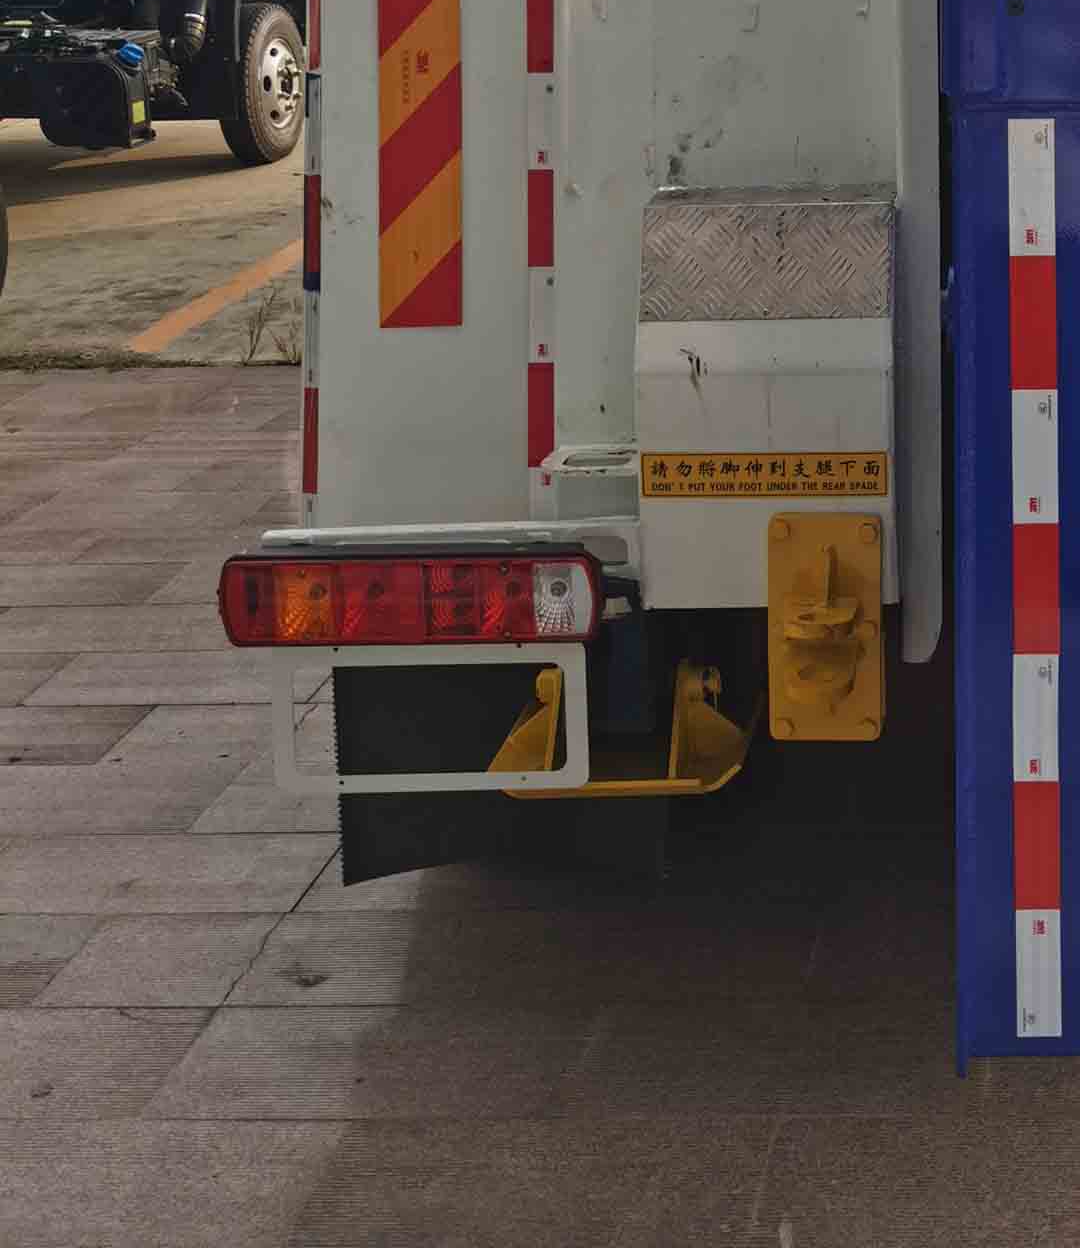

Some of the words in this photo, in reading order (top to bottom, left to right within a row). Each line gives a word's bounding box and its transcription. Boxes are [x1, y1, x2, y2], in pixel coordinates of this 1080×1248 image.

[687, 482, 705, 492] PUT
[710, 482, 736, 492] YOUR
[738, 482, 762, 492] FOOT
[767, 481, 798, 491] UNDER
[802, 481, 818, 491] THE
[823, 481, 846, 491] REAR
[848, 481, 879, 491] SPADE
